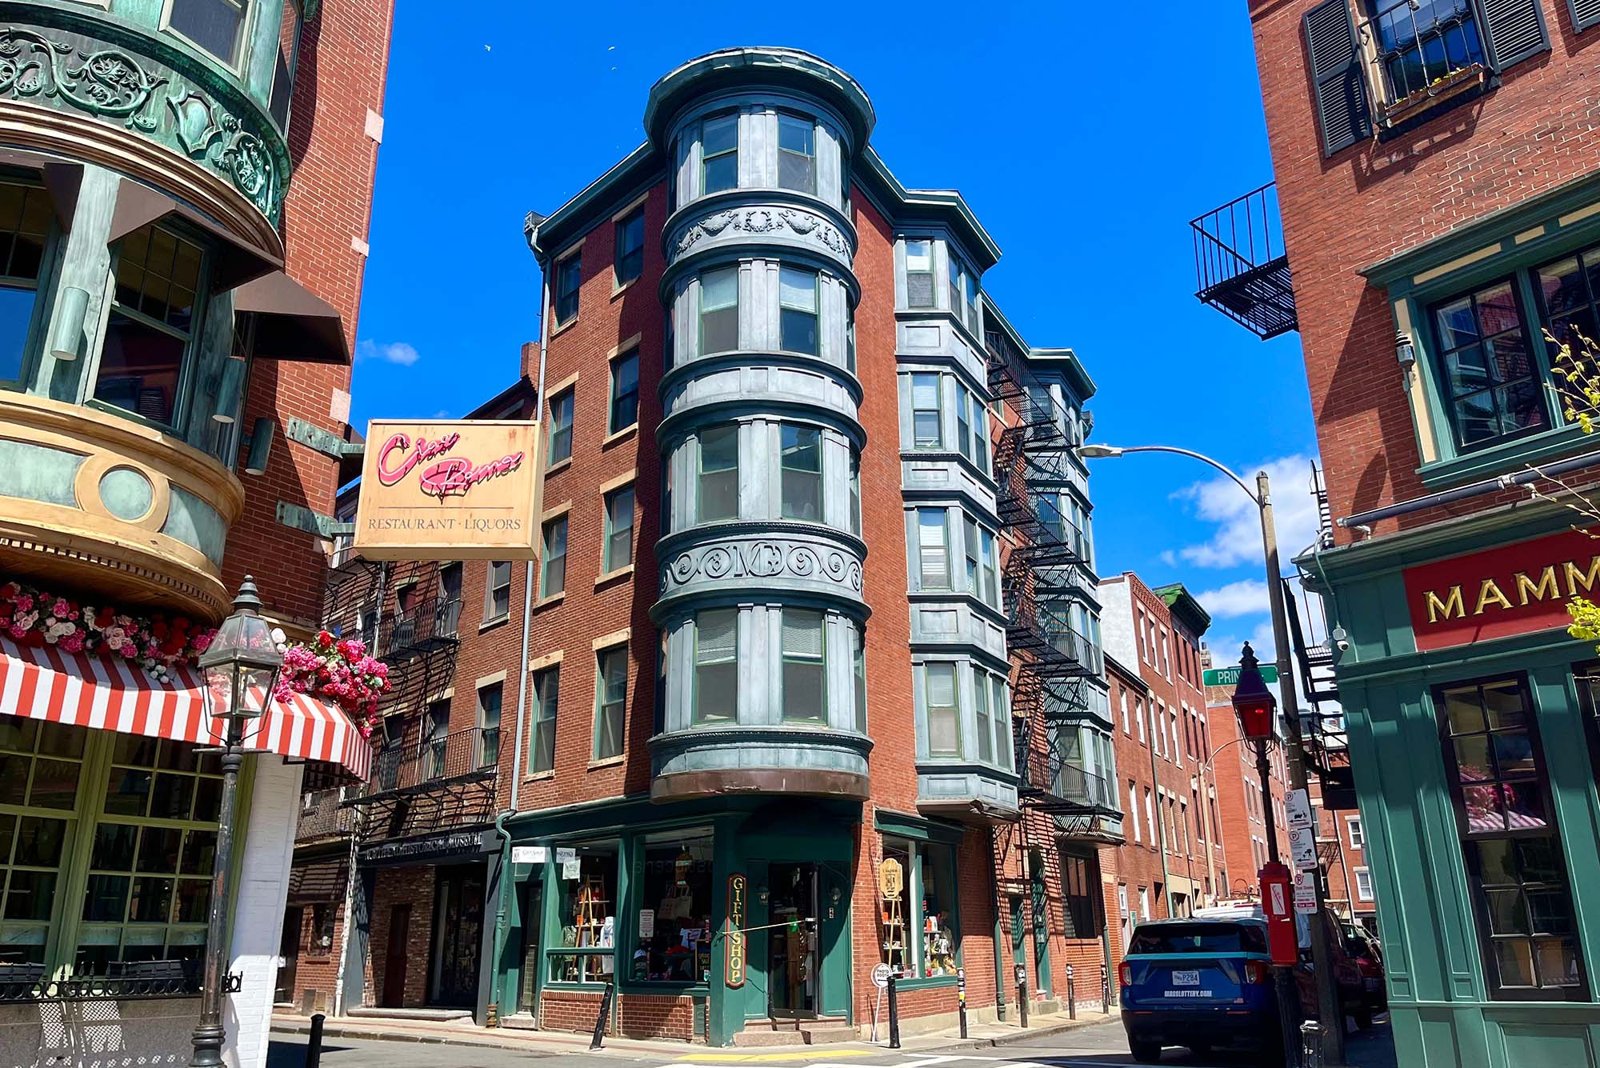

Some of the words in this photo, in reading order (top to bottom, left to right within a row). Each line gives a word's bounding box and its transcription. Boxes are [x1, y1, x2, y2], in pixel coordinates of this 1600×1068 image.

[368, 518, 456, 531] RESTAURANT
[464, 518, 522, 532] LIQUORS
[1217, 669, 1242, 685] PRIN
[732, 877, 743, 926] GIFT
[730, 932, 742, 982] SHOP
